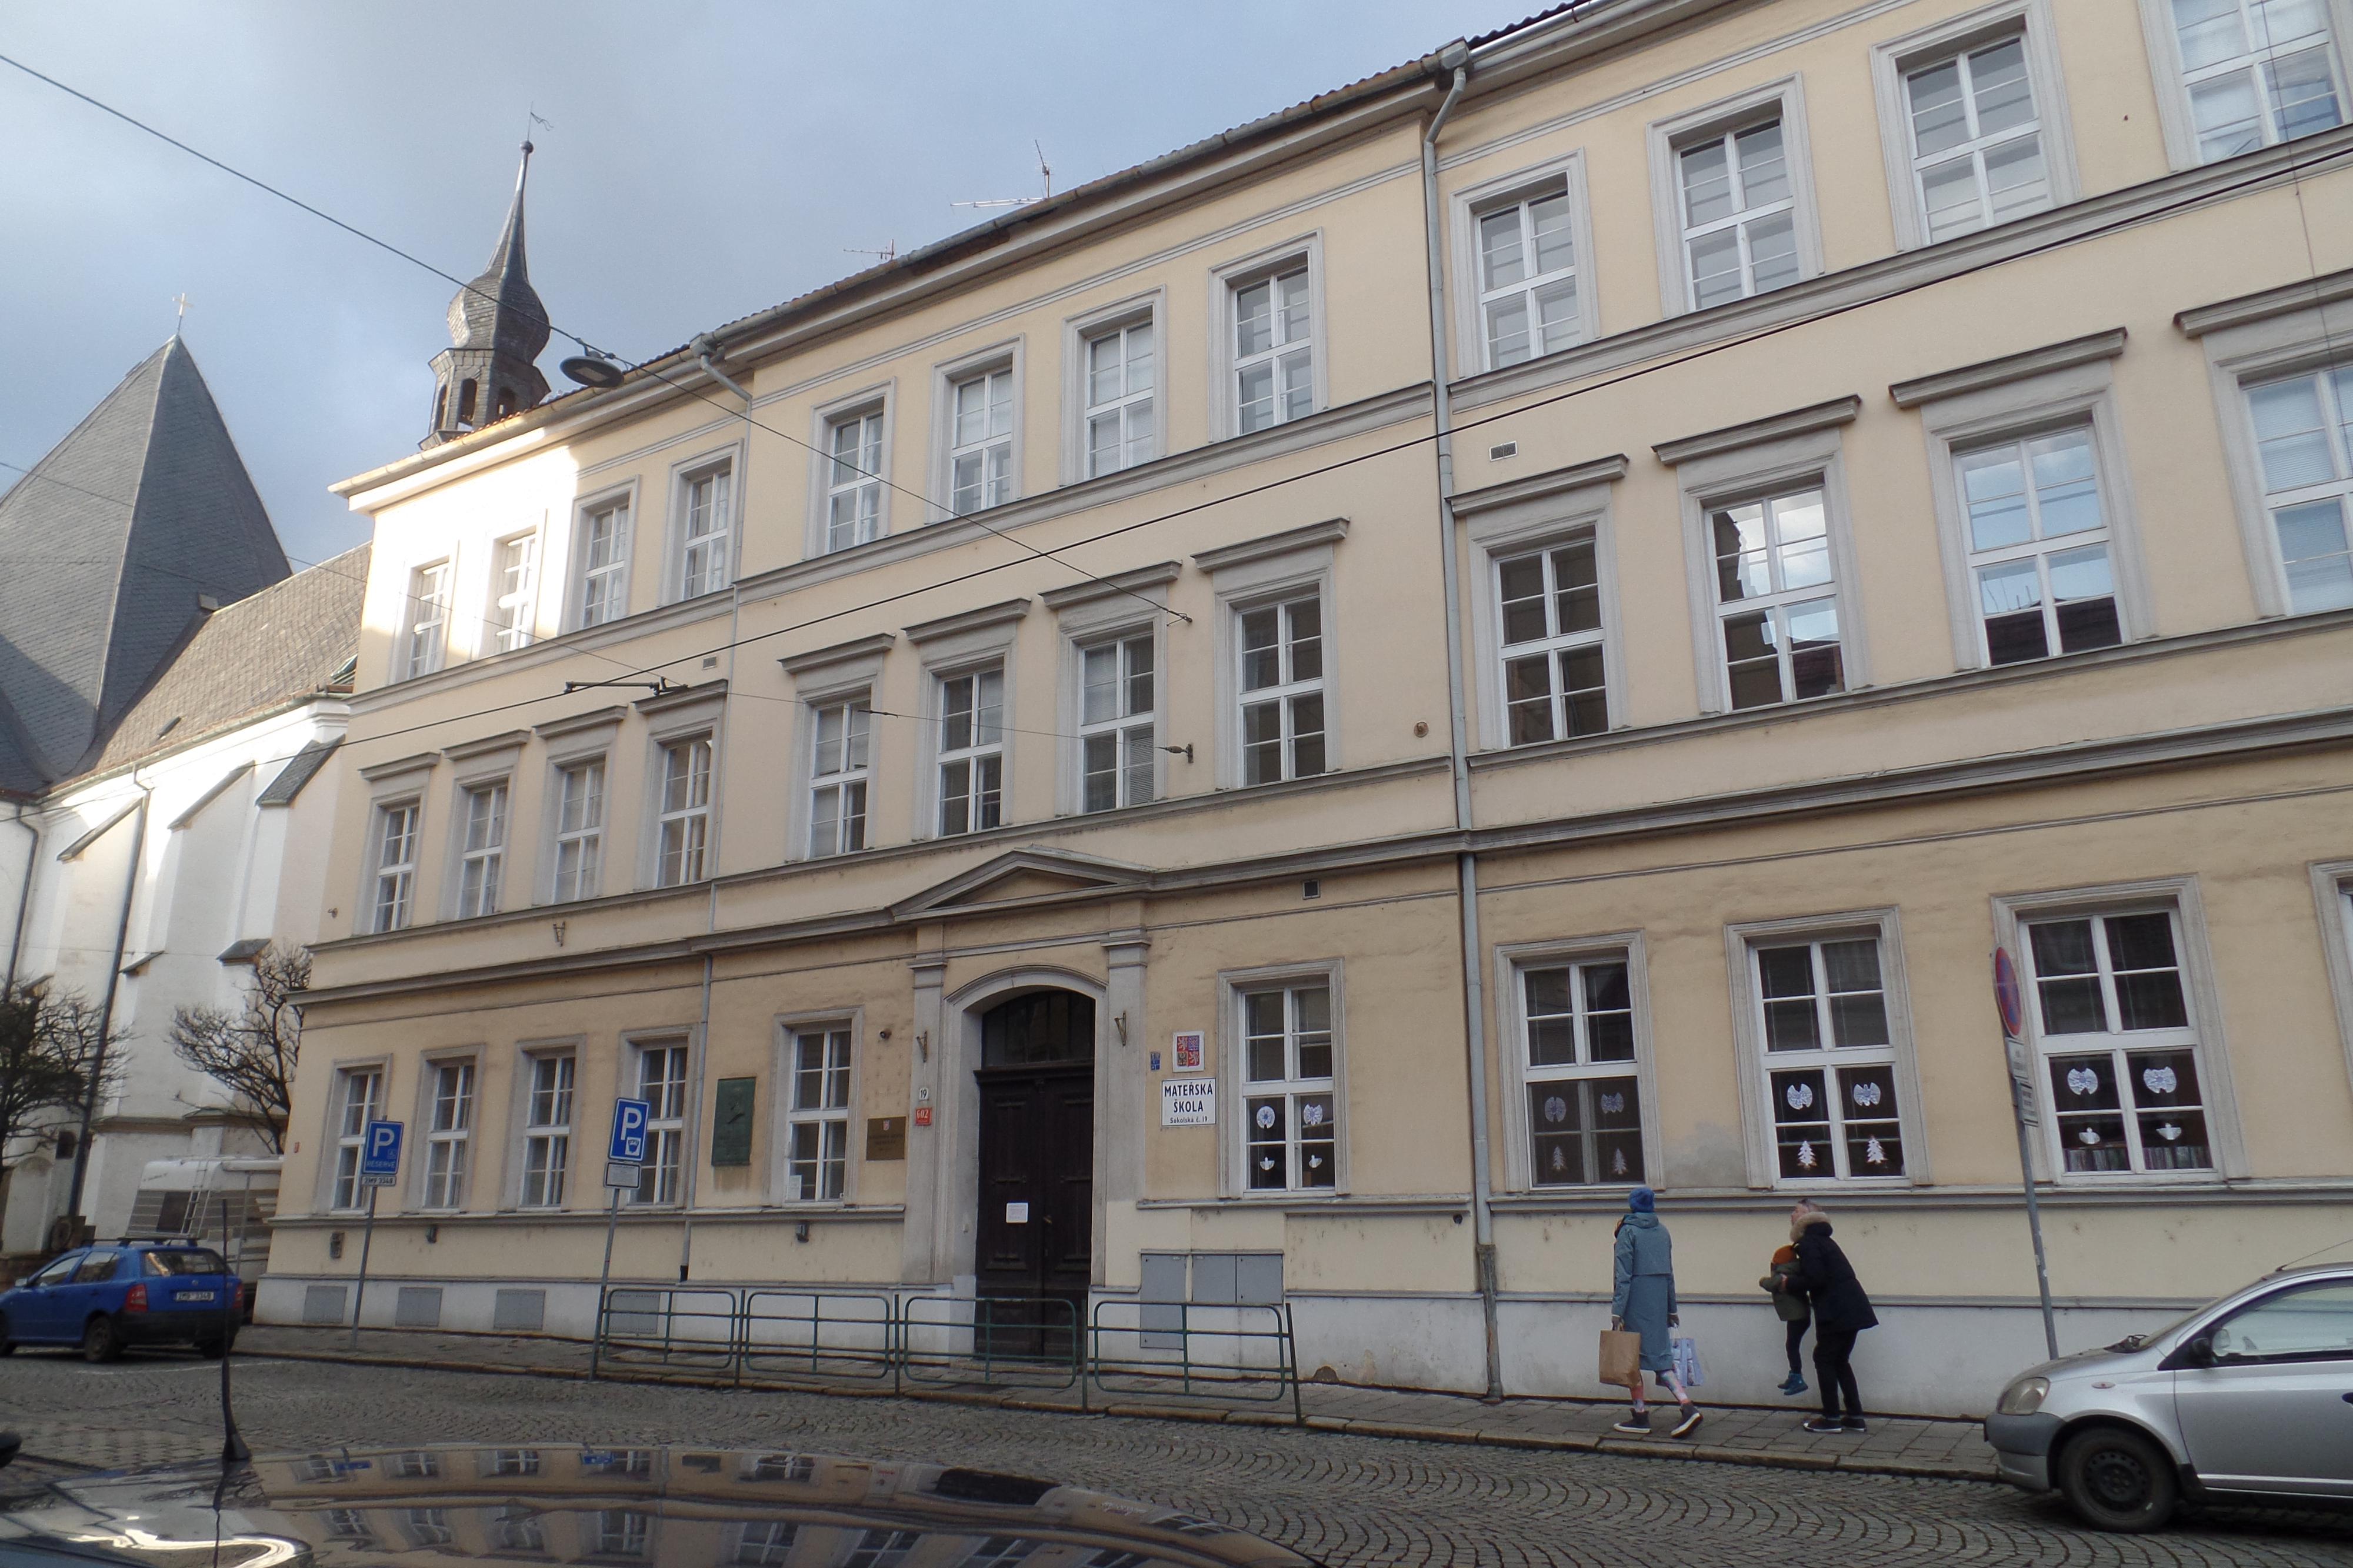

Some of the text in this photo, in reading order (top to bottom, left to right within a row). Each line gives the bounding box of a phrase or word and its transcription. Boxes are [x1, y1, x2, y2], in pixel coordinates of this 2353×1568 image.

[921, 1089, 927, 1098] 19
[1165, 1081, 1213, 1097] MATEŘSKÁ
[1174, 1099, 1203, 1113] ŠKOLA
[917, 1110, 928, 1118] 602
[621, 1107, 642, 1140] P
[373, 1128, 395, 1157] P
